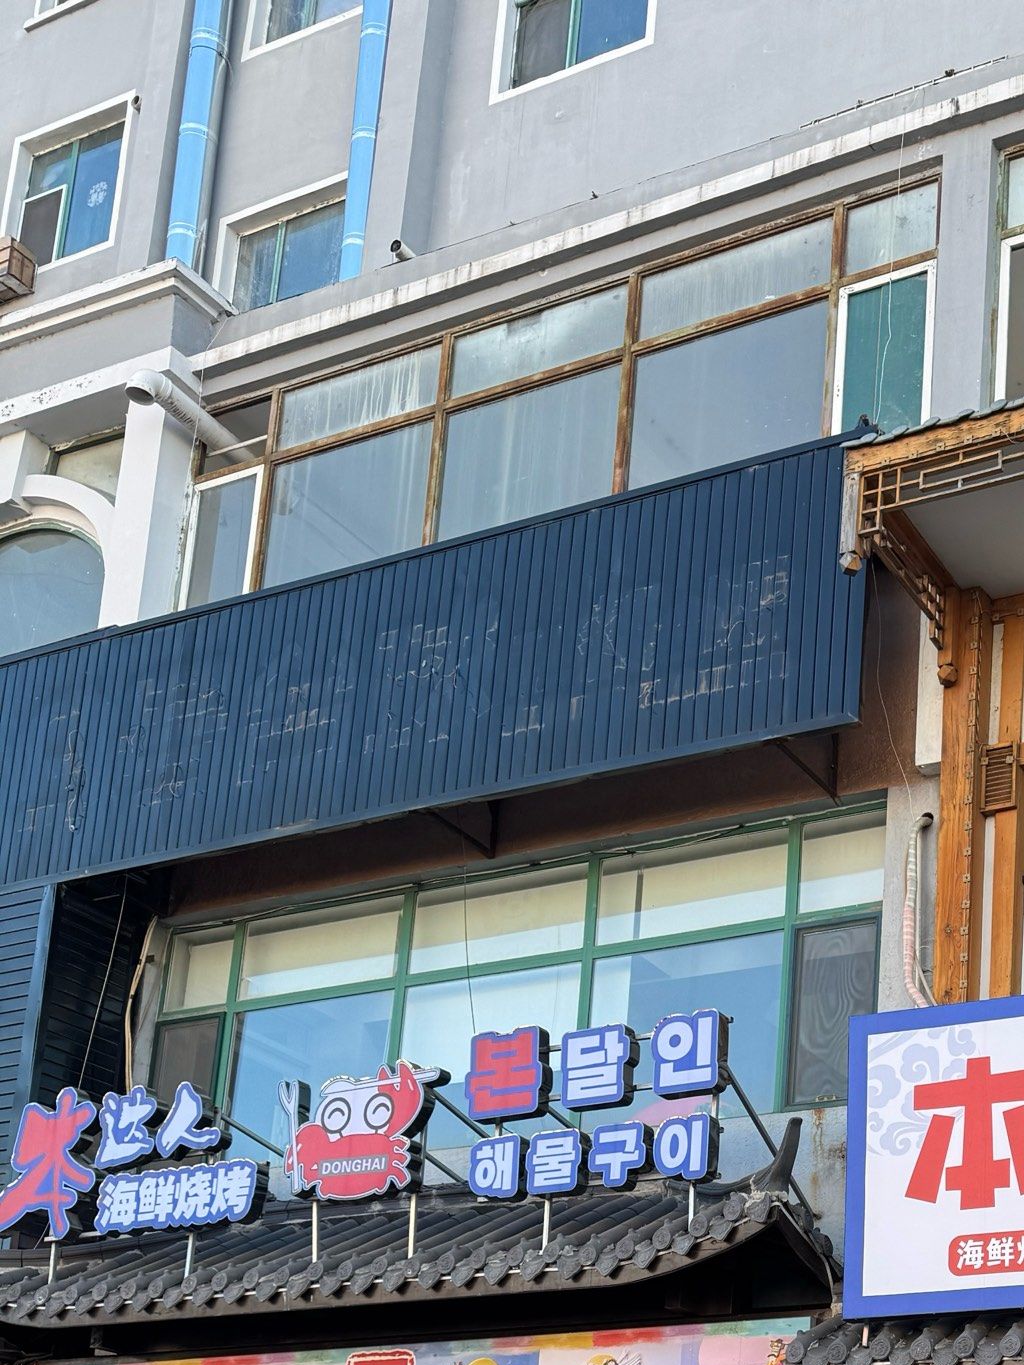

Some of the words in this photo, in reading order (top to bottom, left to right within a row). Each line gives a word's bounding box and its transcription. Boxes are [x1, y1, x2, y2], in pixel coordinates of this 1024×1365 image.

[321, 1157, 386, 1175] DONGHAI
[471, 1116, 707, 1195] 해물구이
[97, 1162, 254, 1232] 海鲜烧烤
